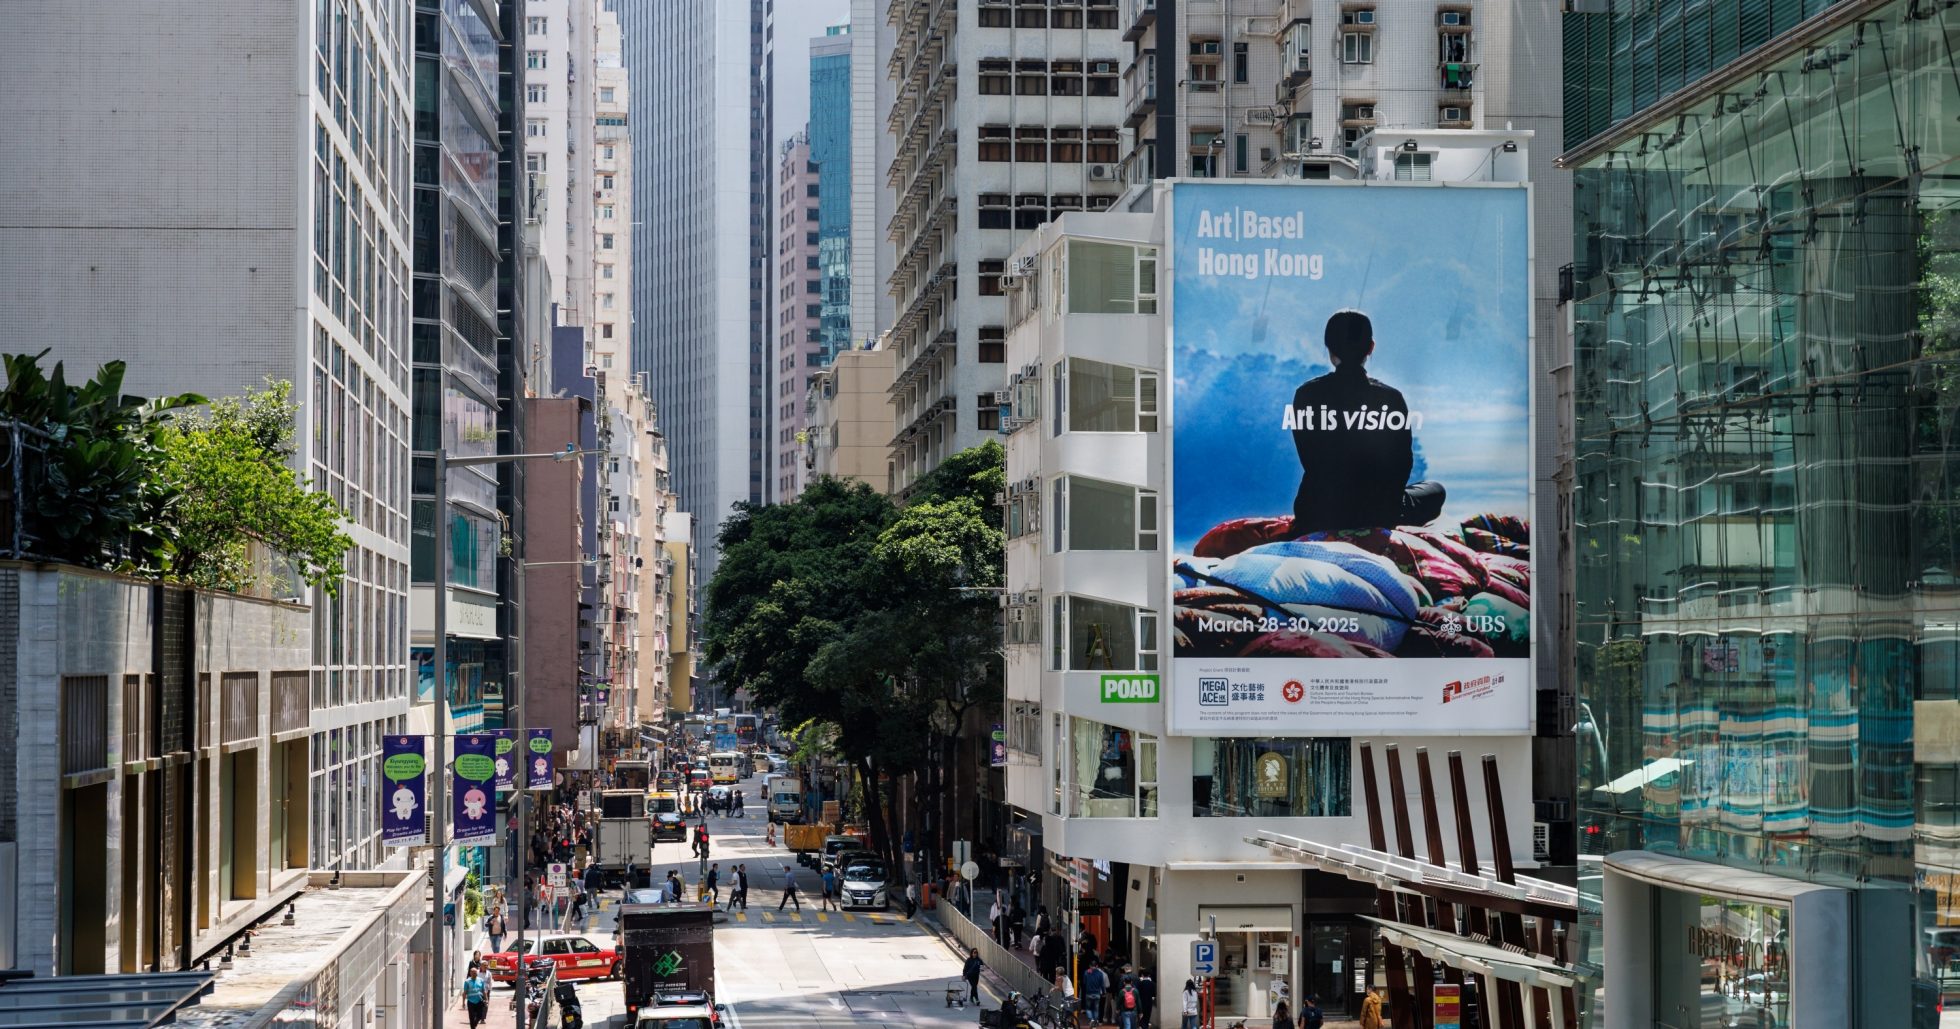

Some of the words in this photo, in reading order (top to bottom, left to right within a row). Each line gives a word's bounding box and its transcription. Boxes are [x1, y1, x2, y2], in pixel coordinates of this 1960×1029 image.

[1197, 210, 1232, 238] Art
[1243, 210, 1304, 239] Basel
[1198, 247, 1259, 280] Hong
[1264, 248, 1324, 281] Kong
[1281, 404, 1315, 430] Art
[1320, 404, 1338, 431] is
[1342, 404, 1424, 431] vision
[1198, 616, 1254, 633] March
[1257, 616, 1315, 636] 28-30,
[1317, 617, 1360, 633] 2025
[1465, 615, 1506, 633] UBS
[1104, 678, 1156, 699] POAD
[1202, 681, 1226, 692] MEGA
[1231, 683, 1265, 692] 文化藝術
[1202, 692, 1219, 703] ACE
[1231, 693, 1265, 701] 盛事基金
[1199, 946, 1211, 961] P
